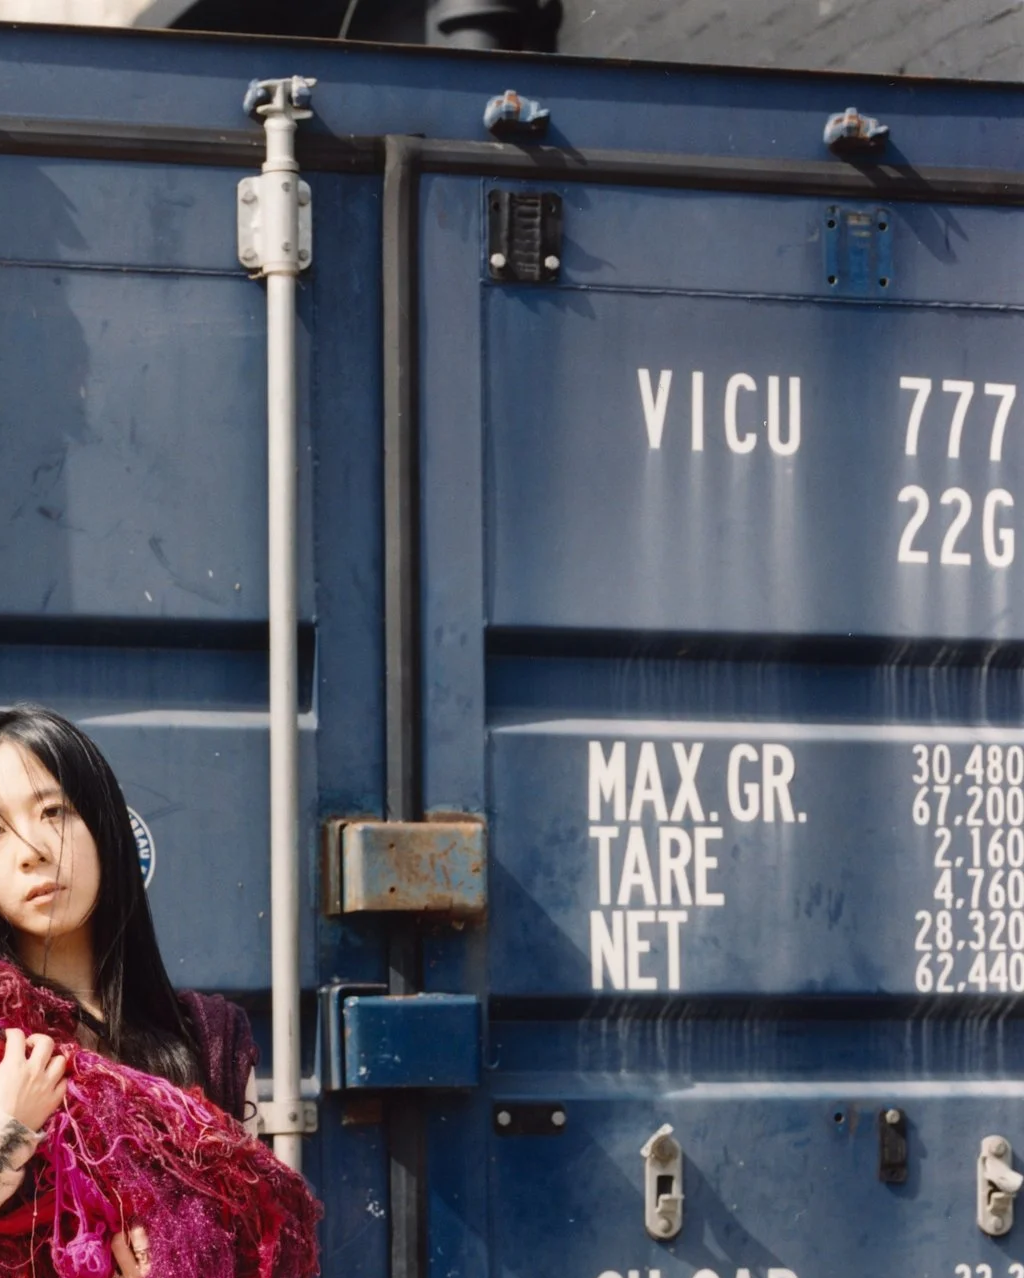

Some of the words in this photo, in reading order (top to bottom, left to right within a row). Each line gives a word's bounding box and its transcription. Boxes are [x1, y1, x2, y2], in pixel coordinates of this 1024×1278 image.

[637, 368, 801, 456] VICU
[899, 376, 1017, 461] 777
[896, 485, 1015, 568] 22G
[588, 826, 725, 906] TARE
[590, 910, 689, 991] NET
